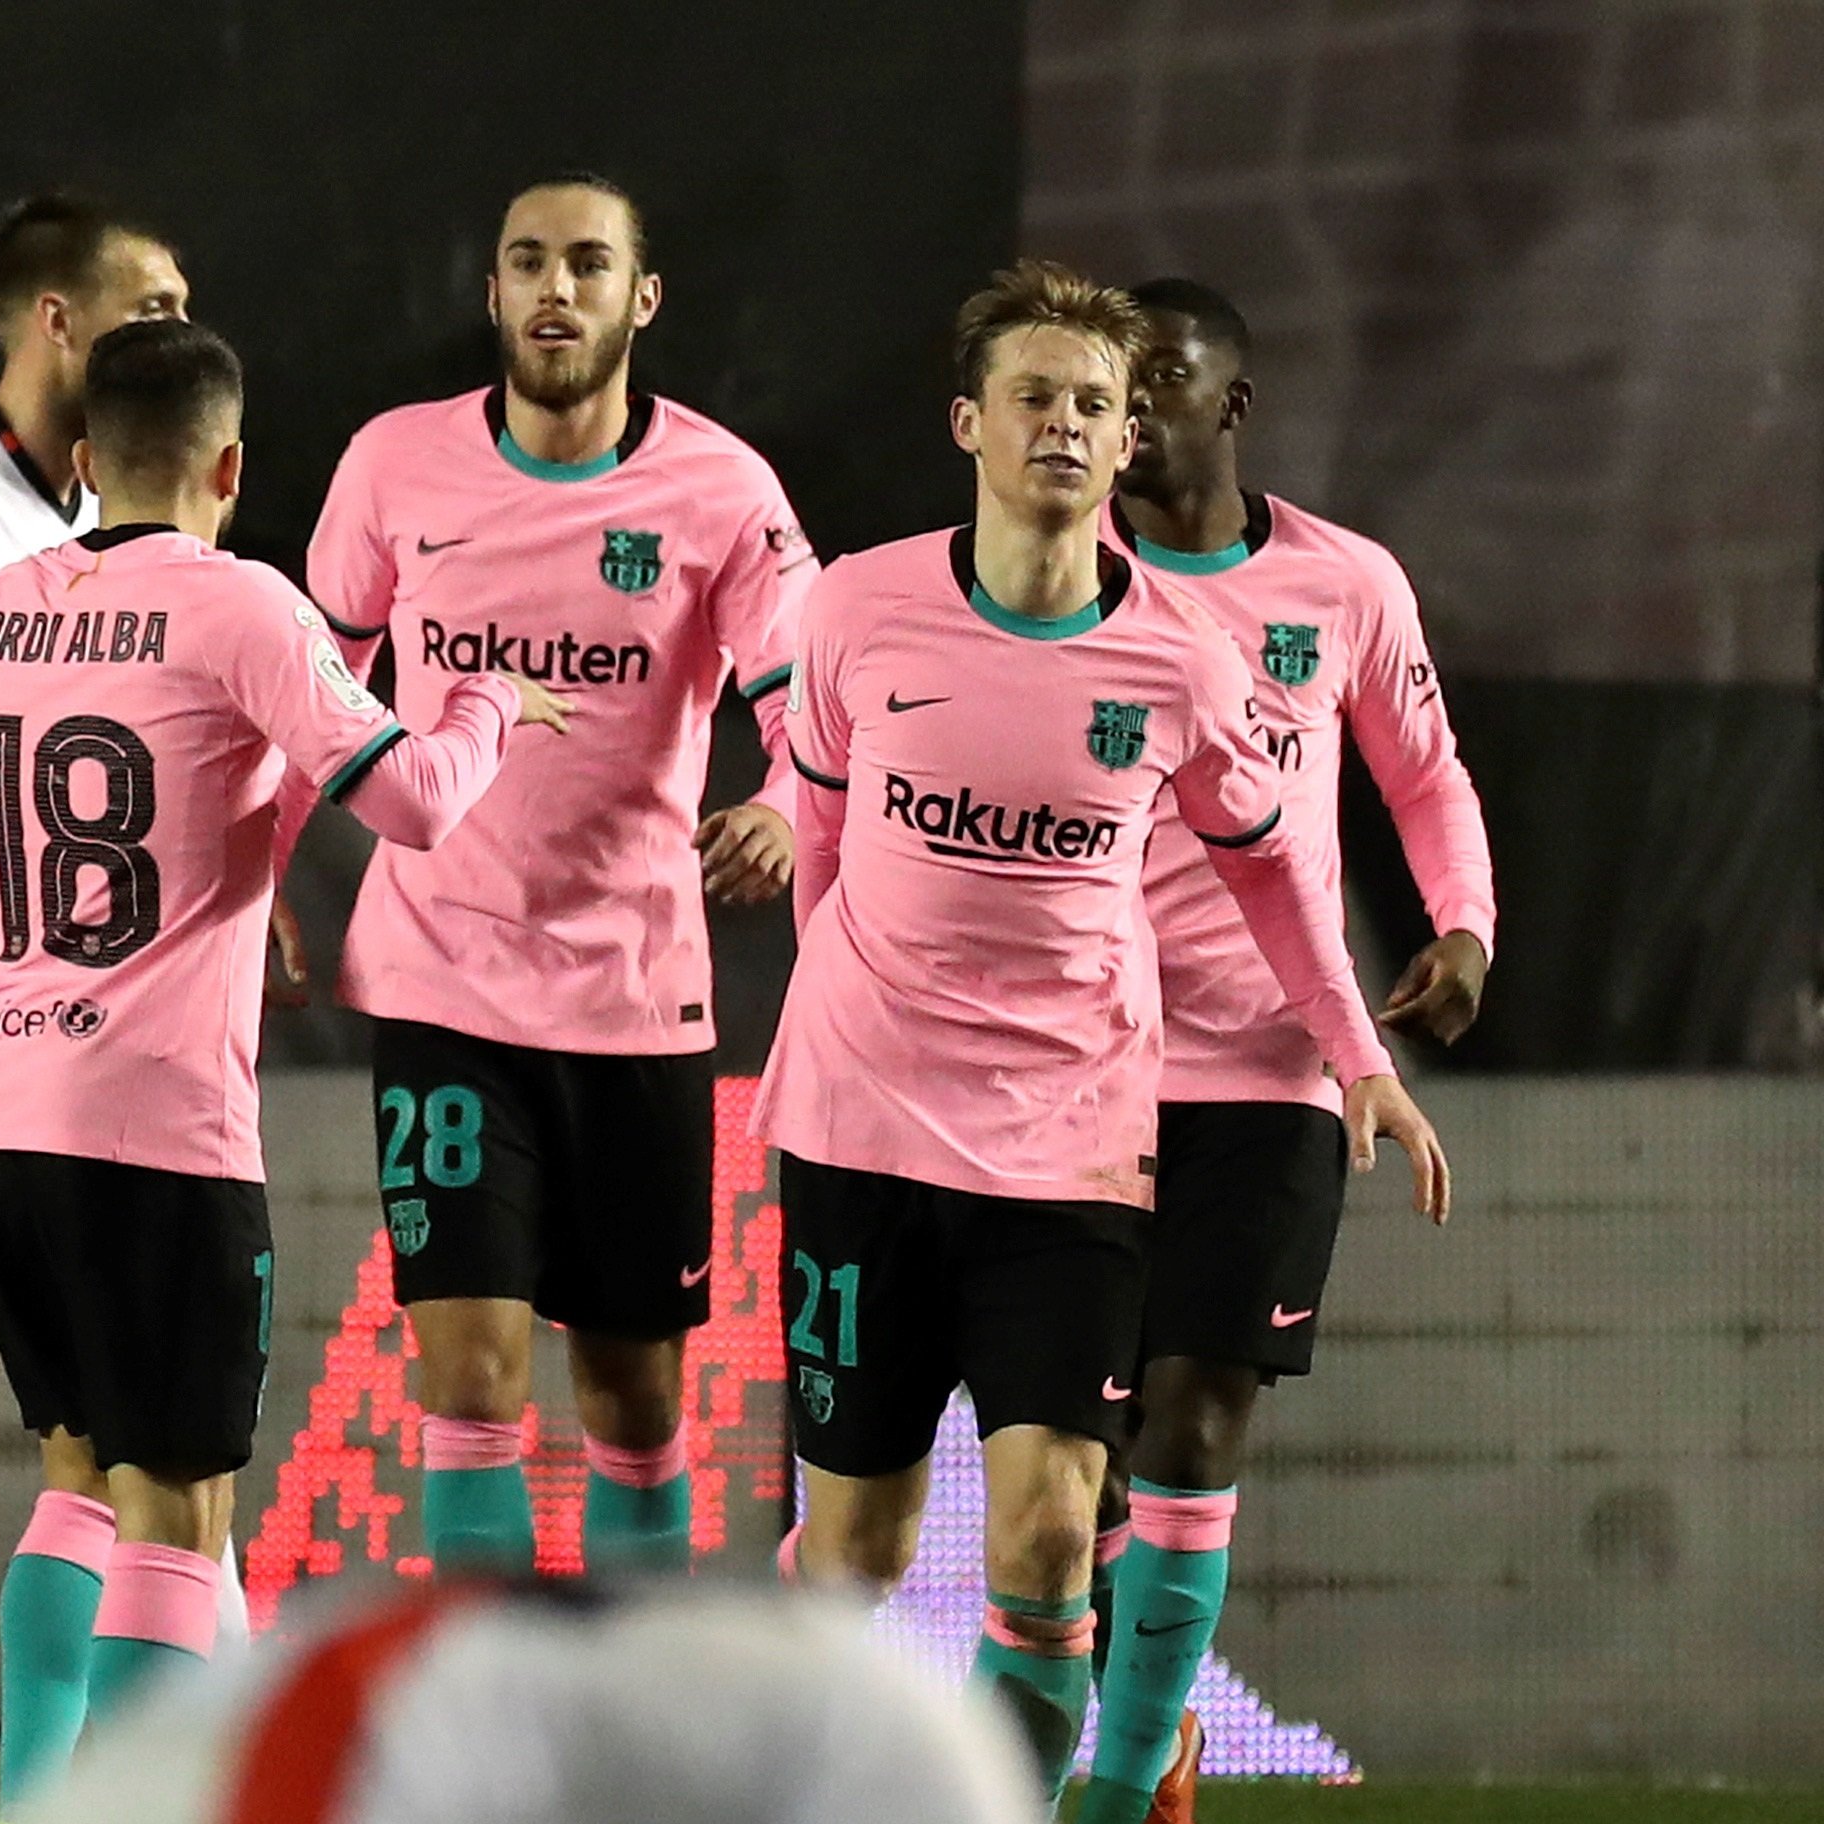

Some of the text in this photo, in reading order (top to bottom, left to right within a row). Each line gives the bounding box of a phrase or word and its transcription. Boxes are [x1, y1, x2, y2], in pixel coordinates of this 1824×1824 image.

[64, 611, 169, 663] ALBA
[422, 618, 650, 684] Rakuten
[883, 772, 1119, 858] Rakuten
[381, 1084, 483, 1189] 28
[790, 1248, 860, 1367] 21
